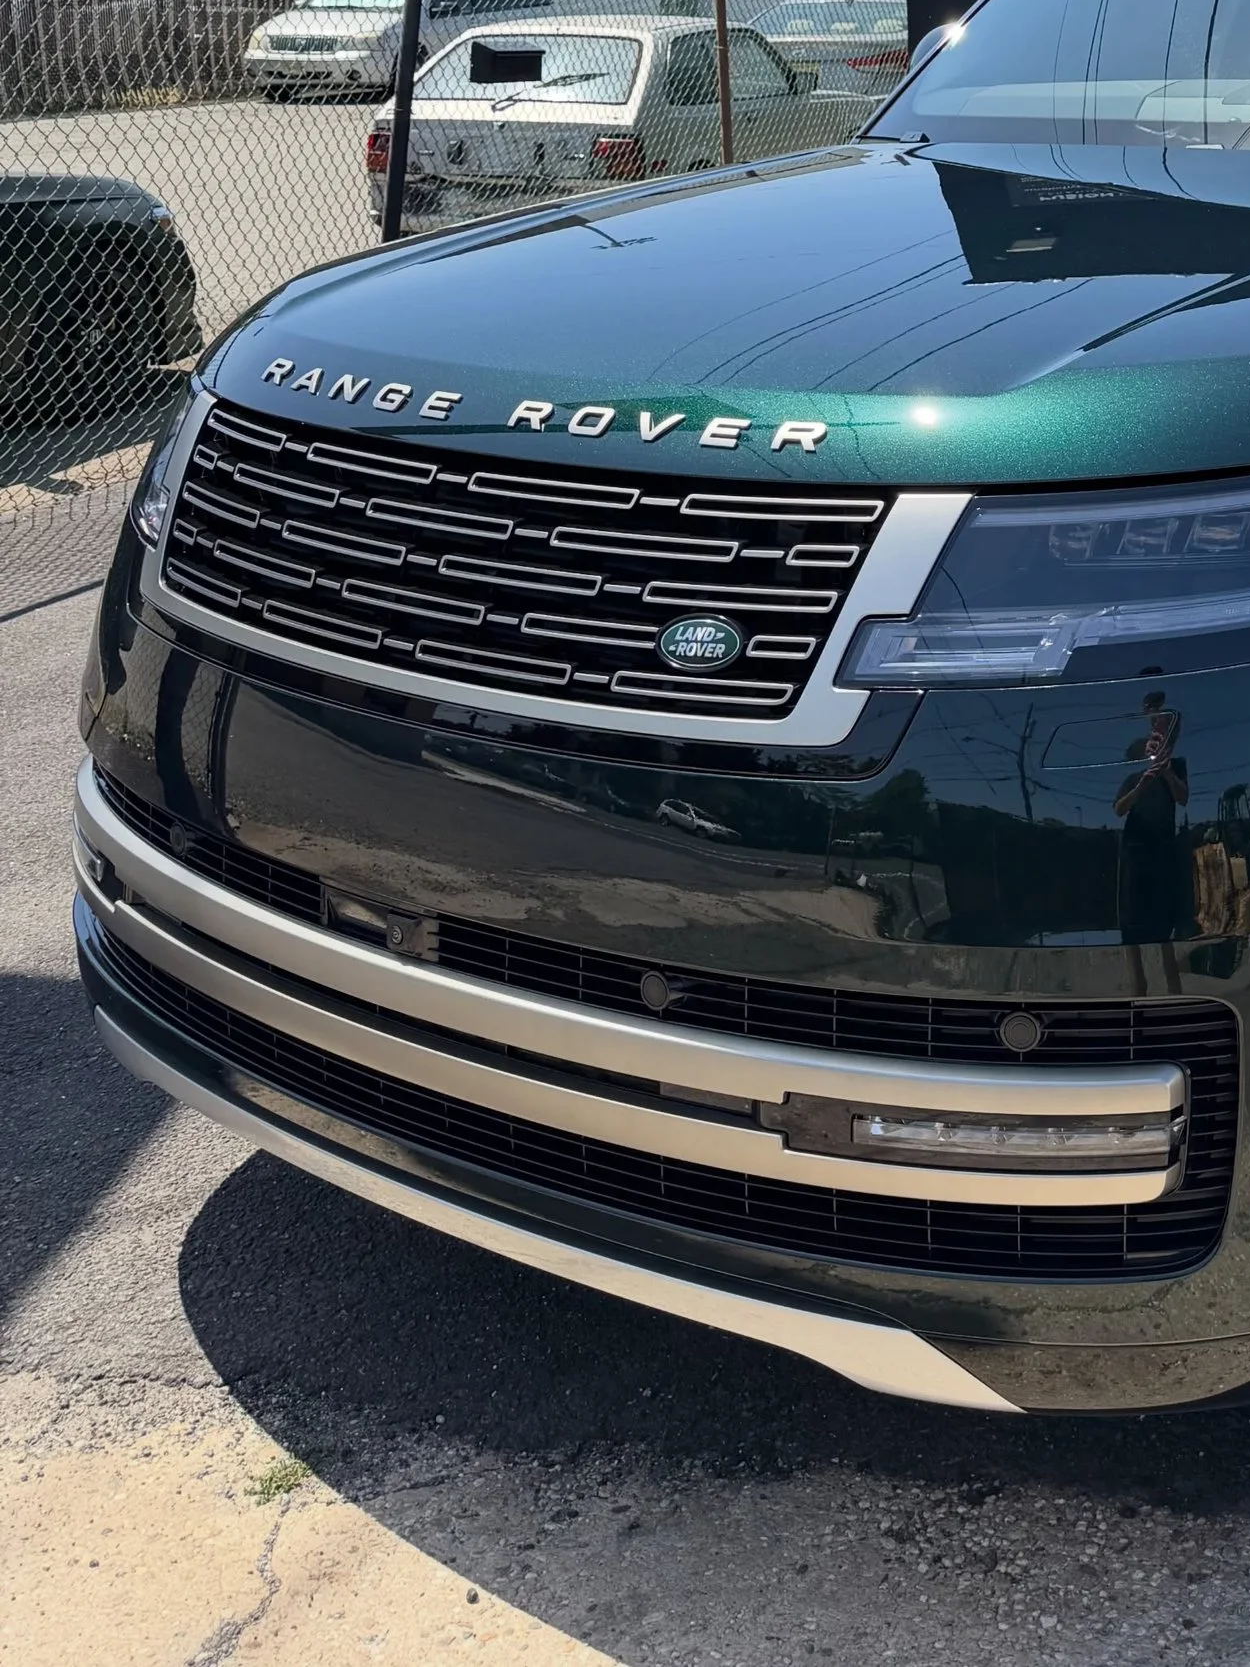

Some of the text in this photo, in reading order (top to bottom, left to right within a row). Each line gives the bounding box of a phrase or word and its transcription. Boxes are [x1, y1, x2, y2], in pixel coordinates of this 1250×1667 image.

[260, 358, 827, 452] RANGE ROVER
[675, 626, 716, 642] LAND
[676, 642, 726, 658] ROVER
